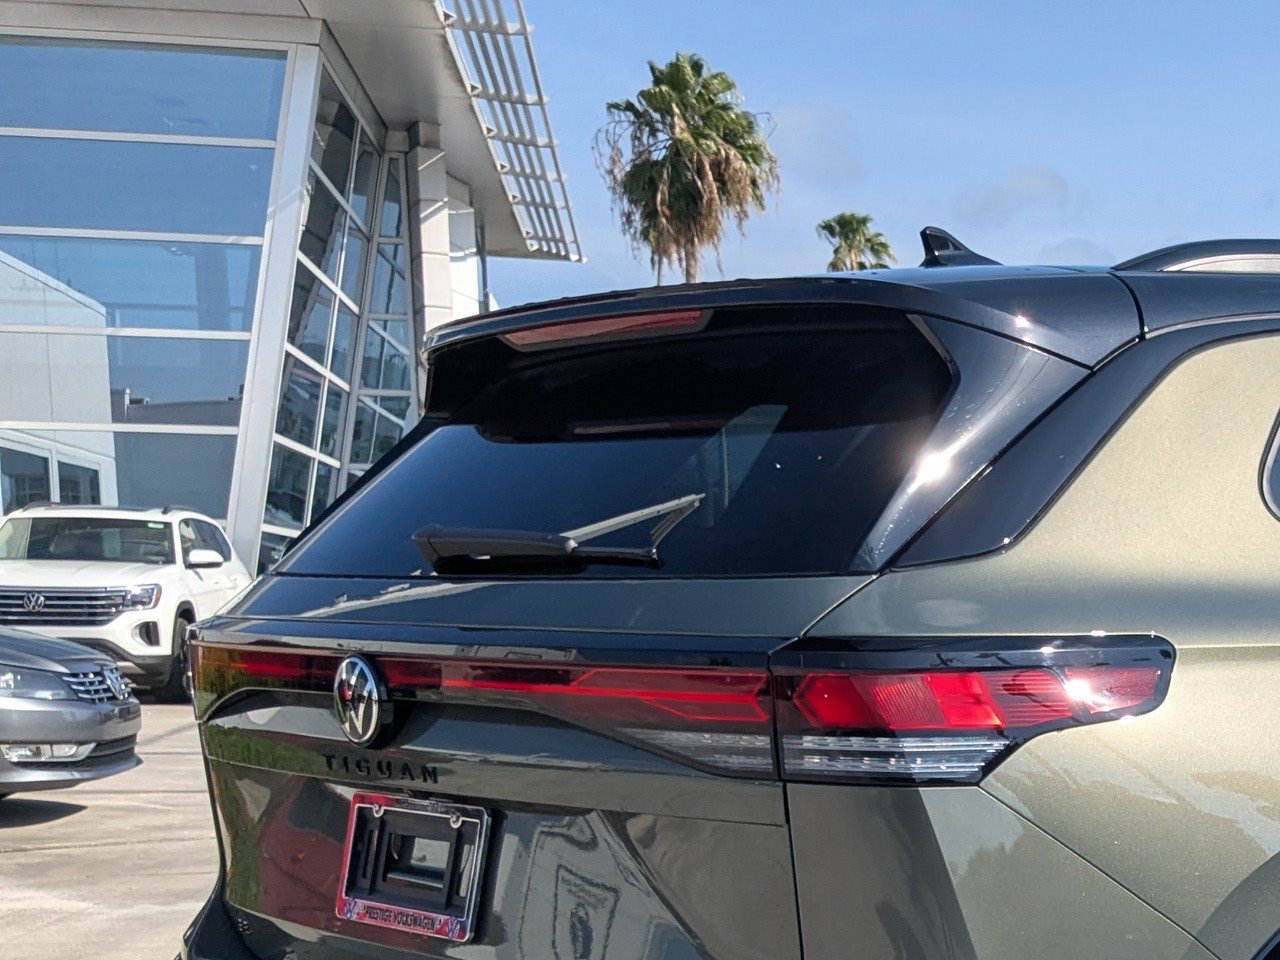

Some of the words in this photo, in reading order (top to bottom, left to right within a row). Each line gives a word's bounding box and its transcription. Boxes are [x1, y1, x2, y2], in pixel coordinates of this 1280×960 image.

[323, 753, 439, 784] TIGUAN
[364, 904, 393, 922] PRESTIGE
[394, 910, 437, 931] VOLKSWAGEN
